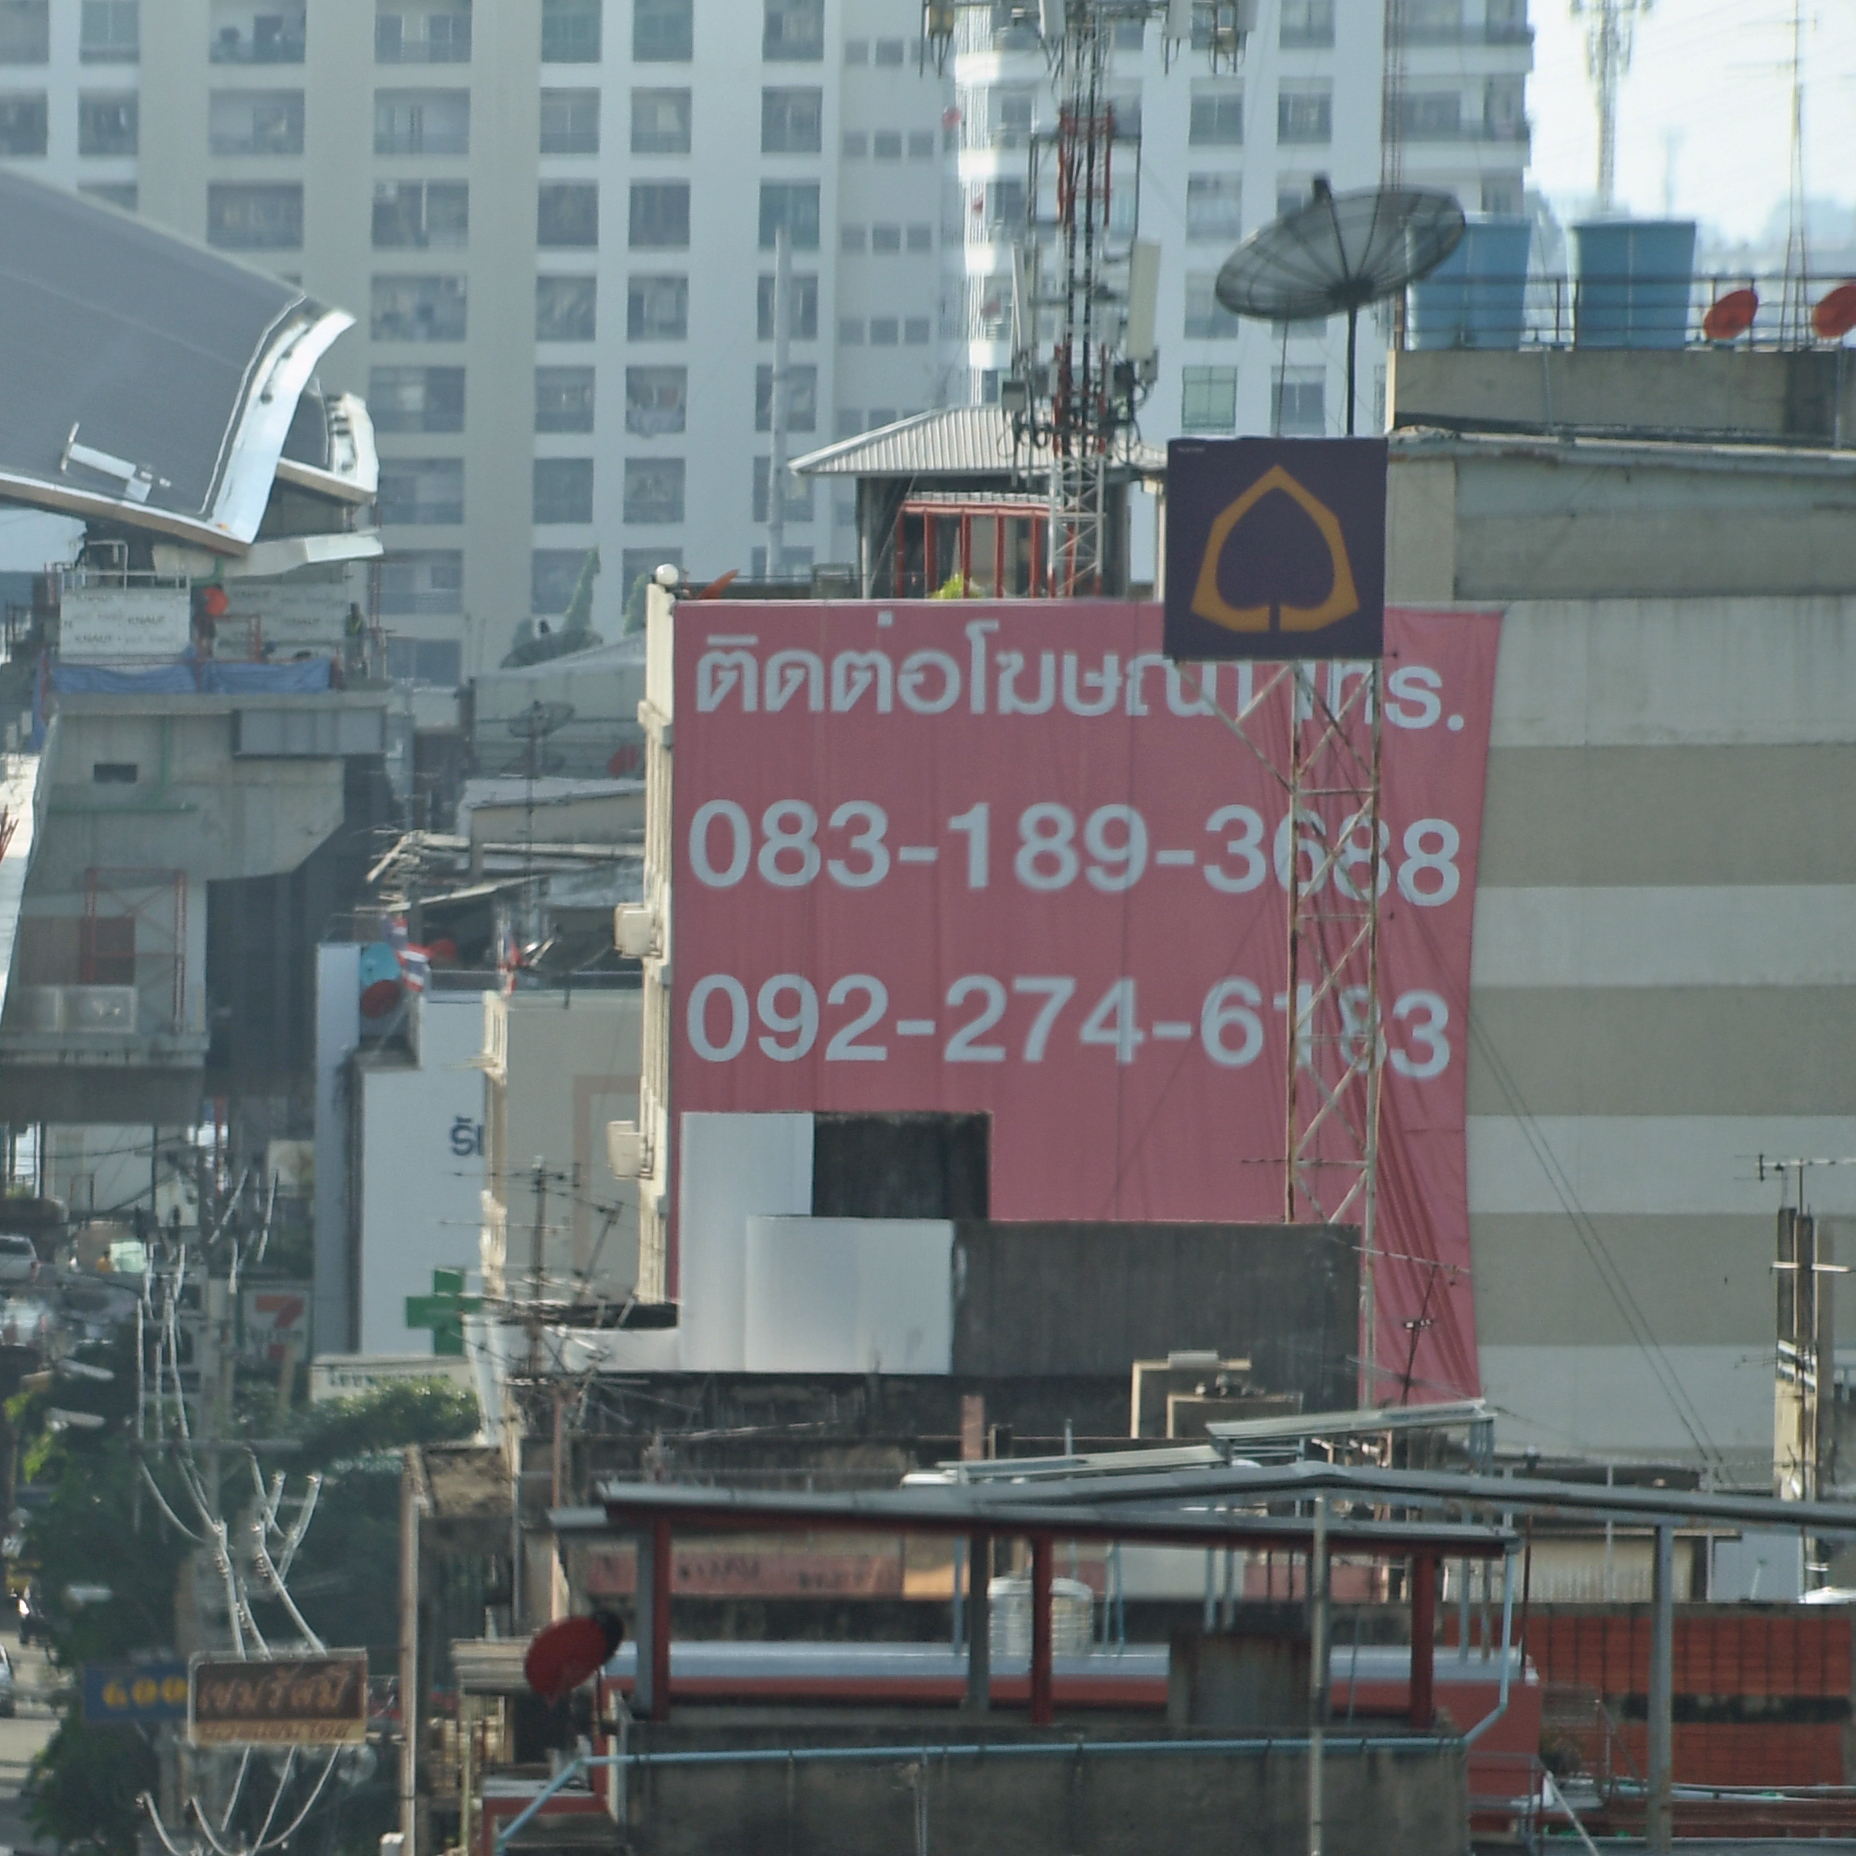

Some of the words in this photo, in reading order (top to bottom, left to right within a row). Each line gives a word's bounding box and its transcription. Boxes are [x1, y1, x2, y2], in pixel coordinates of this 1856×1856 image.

[696, 611, 1254, 717] ติดต่อโฆษณา
[689, 798, 1463, 907] 083-189-3688
[688, 973, 1452, 1079] 092-274-6183
